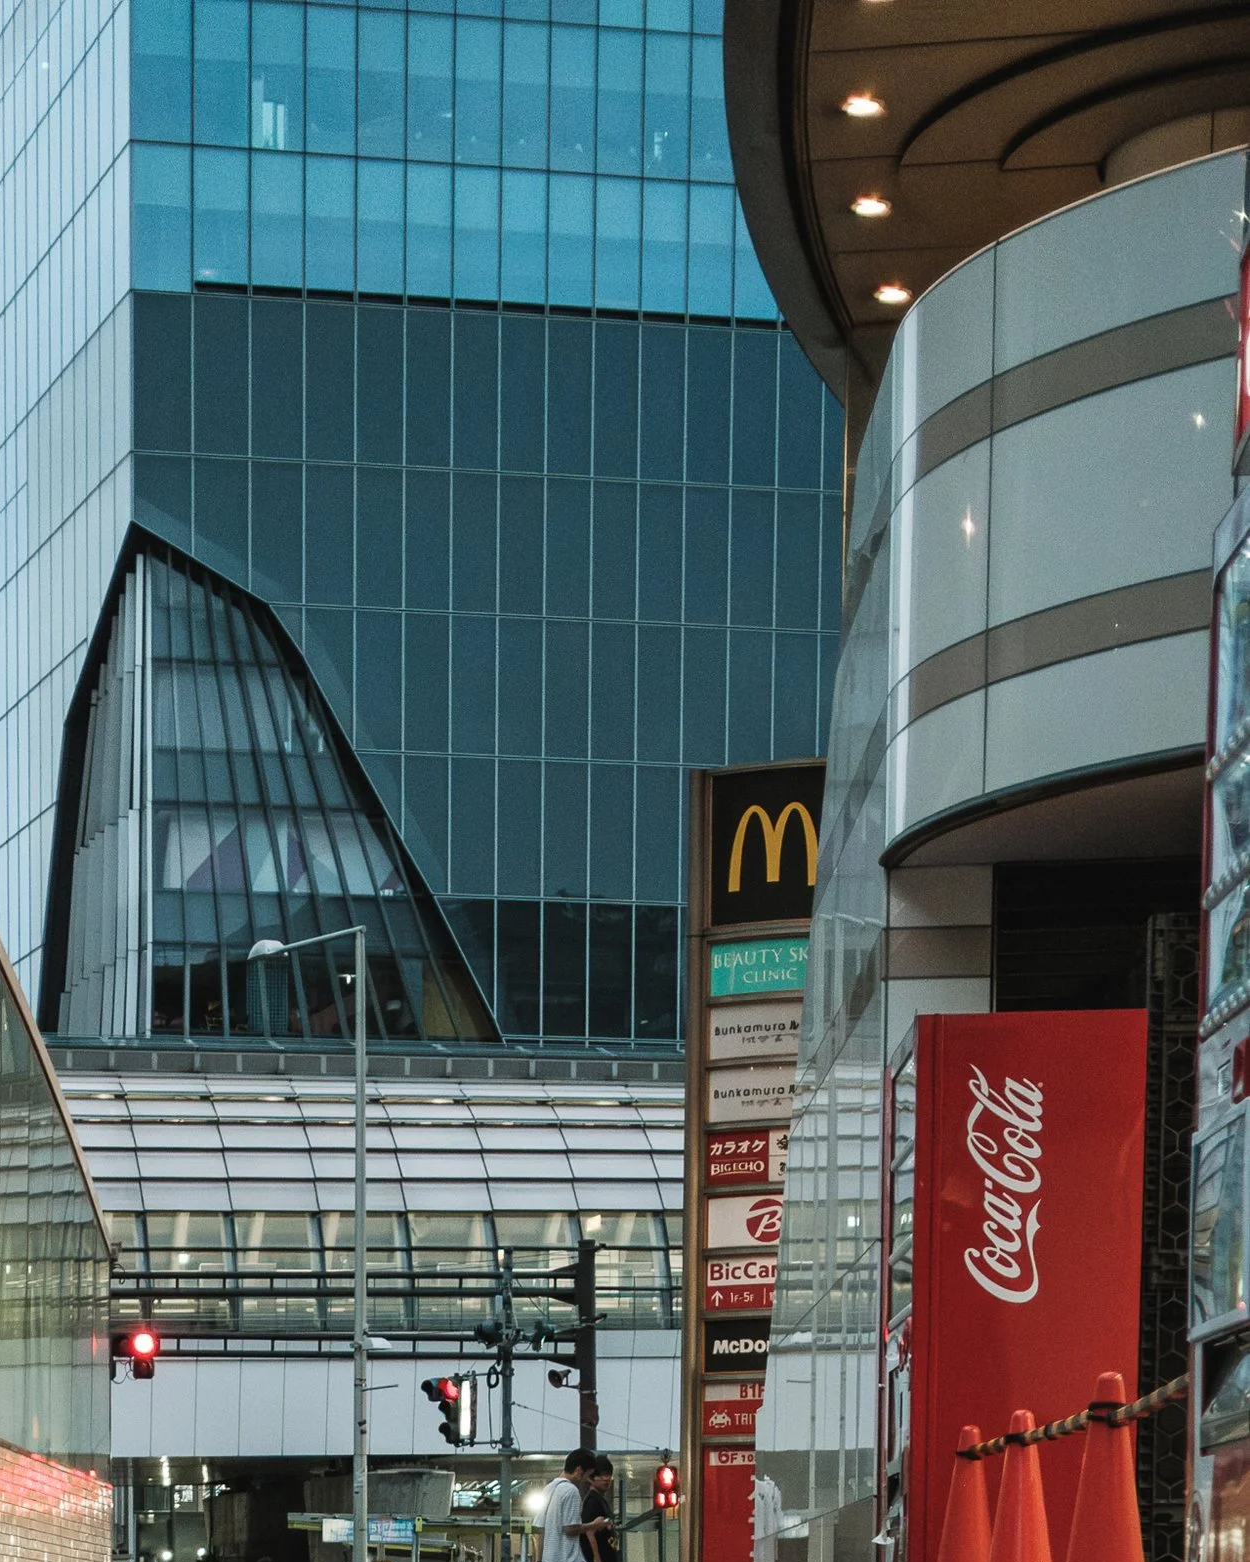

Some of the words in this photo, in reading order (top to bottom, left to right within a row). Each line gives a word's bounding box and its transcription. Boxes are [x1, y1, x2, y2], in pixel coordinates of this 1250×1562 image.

[713, 947, 783, 969] BEAUTY
[743, 967, 797, 984] CLINIC
[714, 1022, 786, 1036] Bunkamura
[713, 1086, 785, 1100] Bunkamura
[710, 1139, 766, 1156] カラオケ
[710, 1162, 731, 1176] BIG
[733, 1160, 765, 1173] ECHO
[964, 1063, 1044, 1304] Coca-Cola
[712, 1338, 769, 1355] McDo
[718, 1448, 738, 1464] 6F
